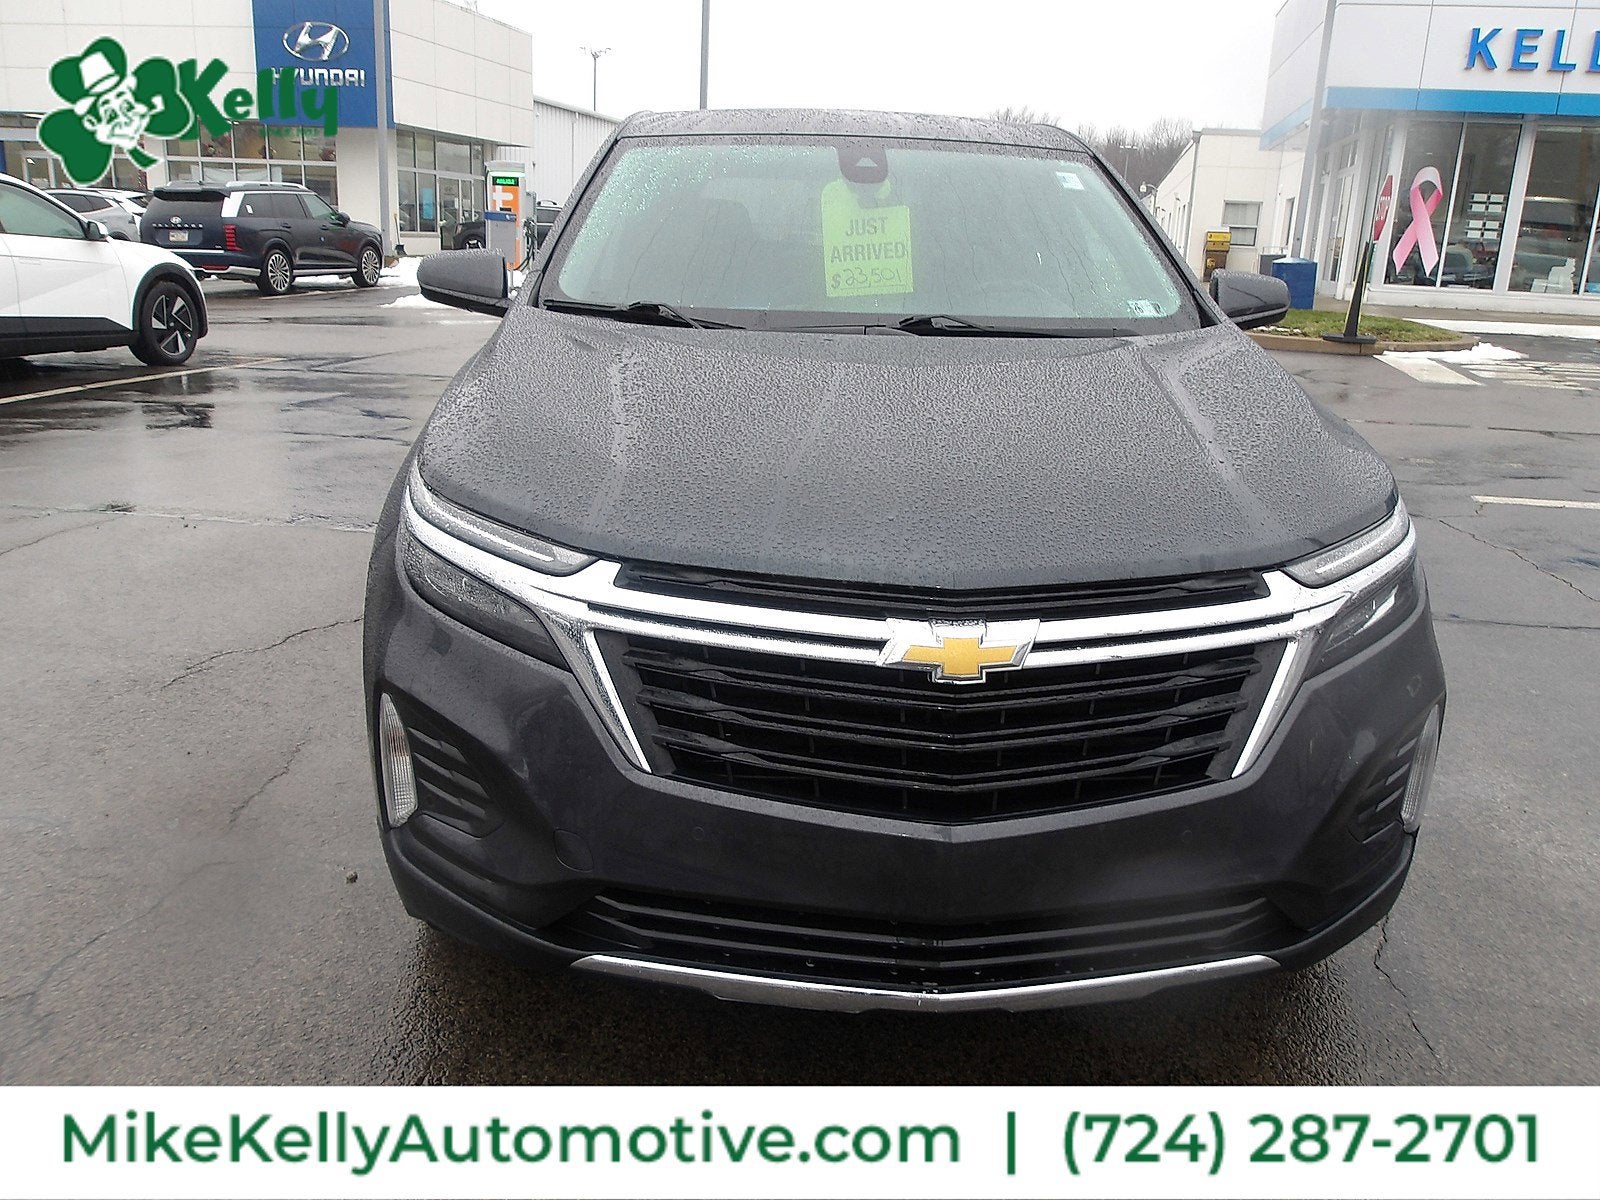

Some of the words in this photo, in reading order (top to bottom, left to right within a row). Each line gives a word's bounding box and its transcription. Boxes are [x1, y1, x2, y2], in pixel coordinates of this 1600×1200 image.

[271, 67, 366, 88] HUNDAI
[845, 216, 889, 237] JUST
[830, 241, 906, 263] ARRIVED
